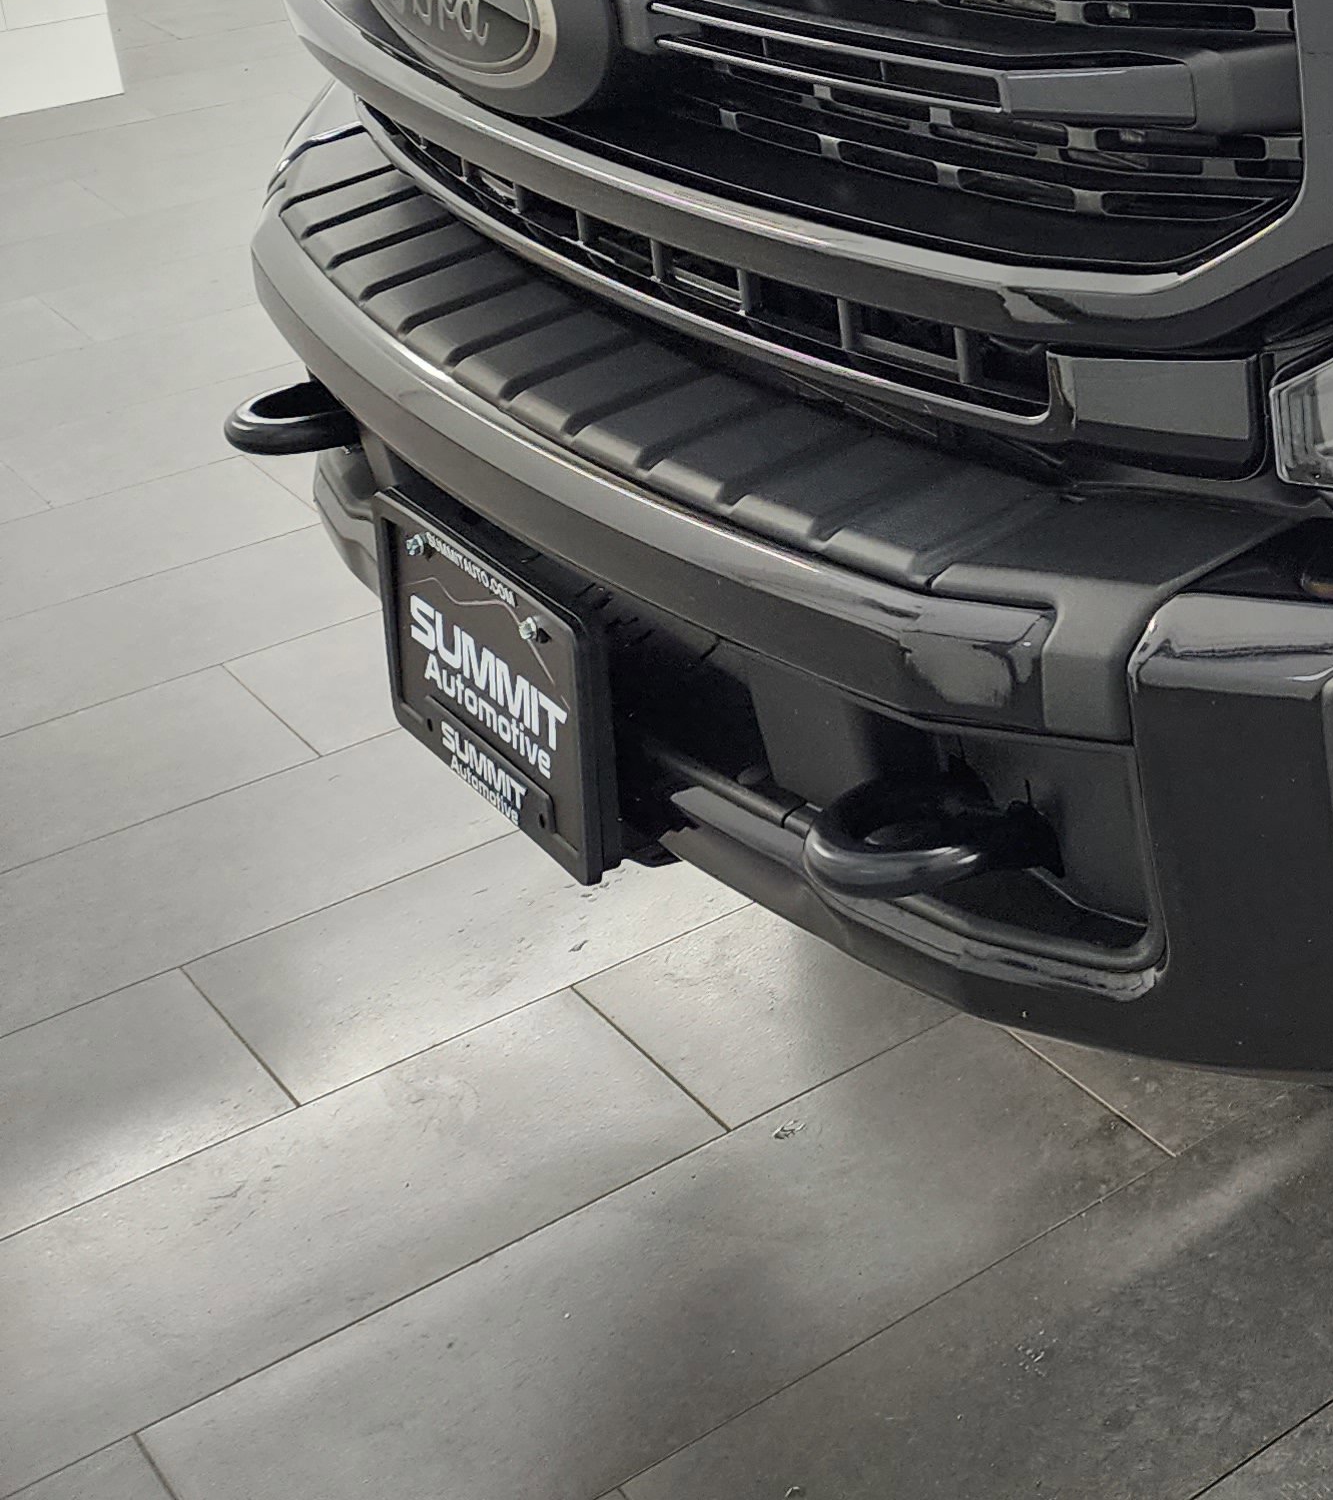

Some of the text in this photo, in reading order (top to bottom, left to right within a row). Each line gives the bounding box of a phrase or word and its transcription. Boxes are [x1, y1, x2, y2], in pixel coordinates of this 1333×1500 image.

[426, 532, 518, 608] SUMMITAUTO.COM
[410, 594, 568, 752] SUMMIT
[423, 652, 552, 780] Automotive
[440, 720, 528, 810] SUMMIT
[448, 753, 520, 827] Automotive
